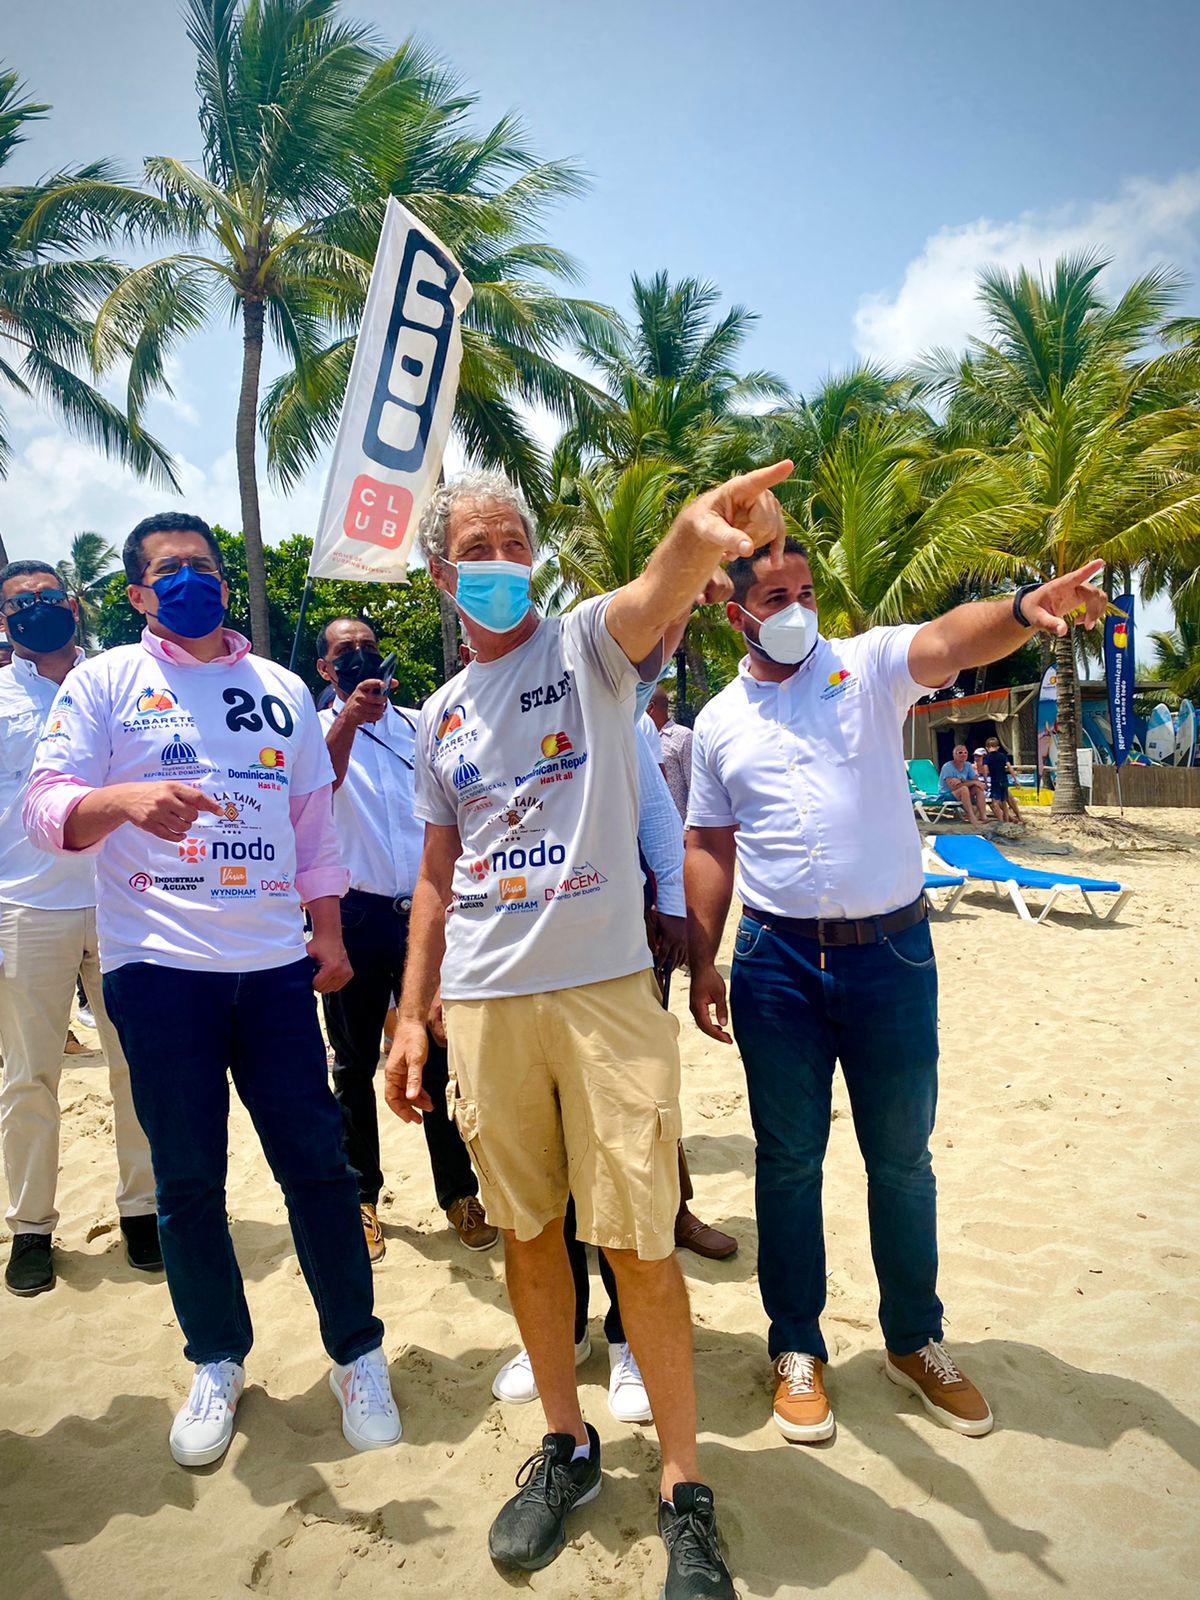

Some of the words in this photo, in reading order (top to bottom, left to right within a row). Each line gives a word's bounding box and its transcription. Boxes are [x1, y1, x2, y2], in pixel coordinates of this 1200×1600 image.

[123, 717, 195, 728] CABARETE
[222, 687, 294, 738] 20
[228, 768, 275, 780] Dominican
[540, 776, 555, 785] Has
[213, 792, 229, 801] LA
[234, 792, 262, 812] TAINA
[212, 837, 275, 861] nodo
[492, 840, 566, 872] nodo
[545, 872, 599, 901] DMICEM
